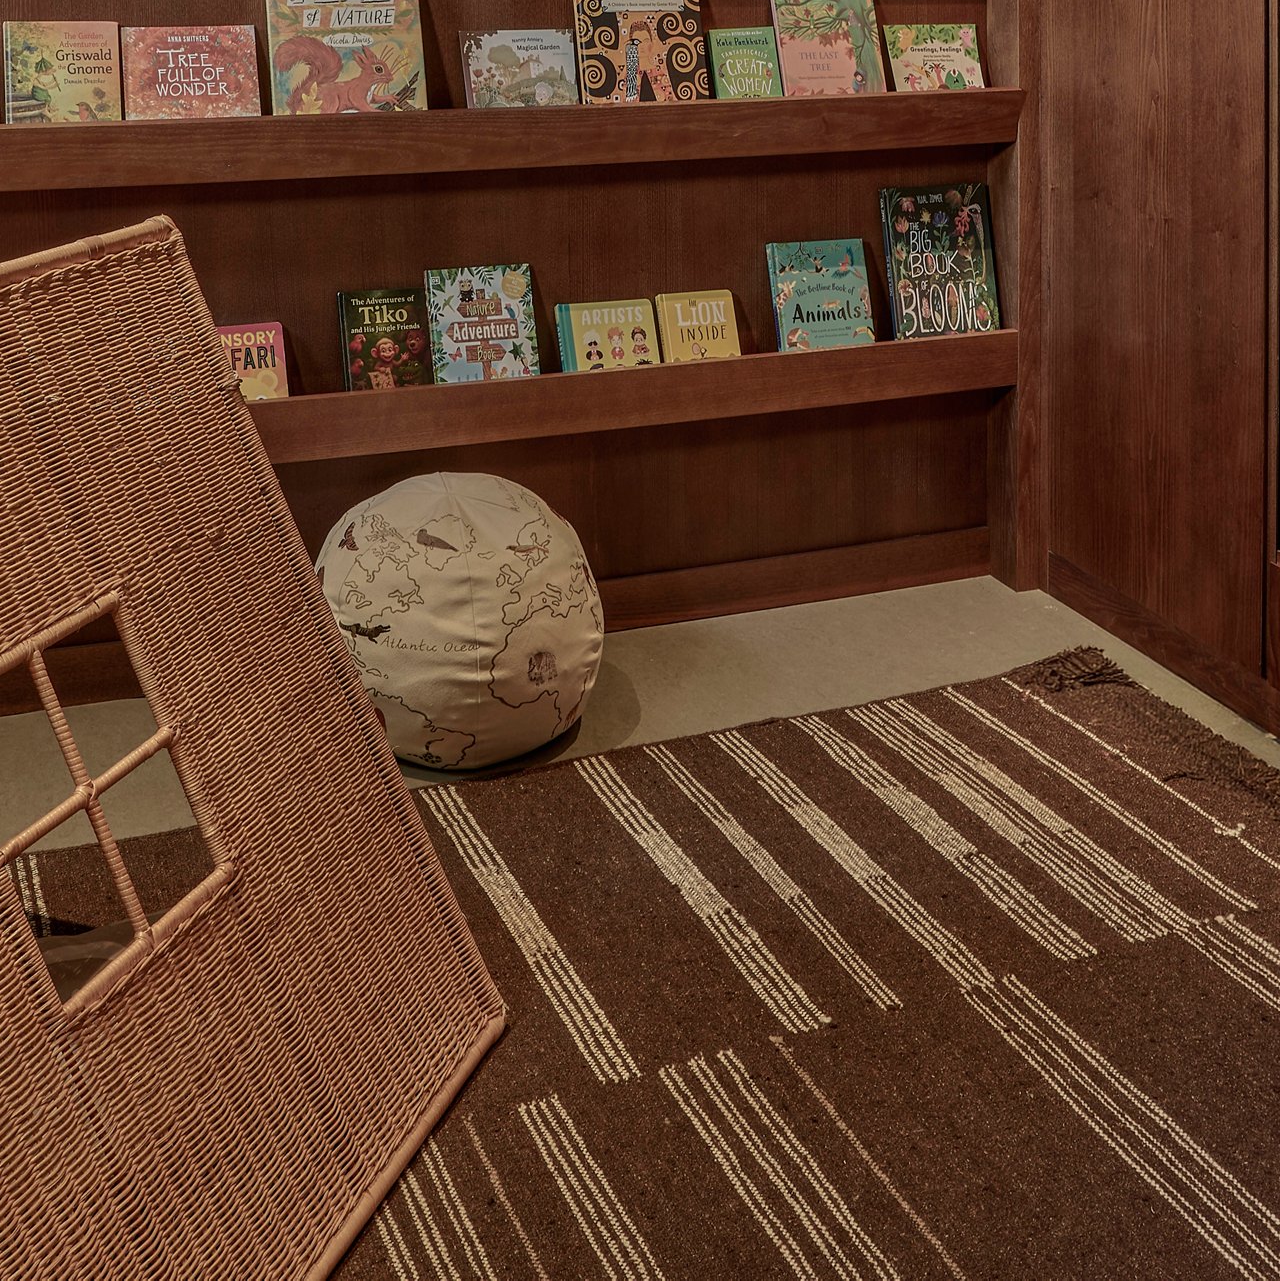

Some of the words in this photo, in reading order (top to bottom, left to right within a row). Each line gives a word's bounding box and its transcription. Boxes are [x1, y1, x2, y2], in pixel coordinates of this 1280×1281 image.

[306, 9, 320, 26] of
[332, 8, 394, 27] NATURE
[59, 40, 99, 48] Adventures
[326, 36, 350, 45] Nicola
[352, 36, 371, 45] Davies
[716, 38, 732, 47] Kate
[734, 37, 768, 46] Pankhurst
[55, 49, 112, 61] Griswald
[156, 47, 212, 68] TREE
[721, 49, 768, 59] FANTASTICALLY
[820, 51, 839, 59] LAST
[67, 63, 113, 74] Gnome
[158, 68, 200, 82] FULL
[202, 67, 225, 81] OF
[726, 59, 766, 76] GREAT
[809, 63, 833, 71] TREE
[156, 82, 229, 97] WONDER
[722, 77, 772, 96] WOMEN
[916, 194, 928, 204] YUVAL
[929, 194, 943, 203] ZOMMER
[909, 222, 920, 230] THE
[910, 230, 932, 254] BIG
[909, 250, 961, 278] BOOK
[796, 289, 807, 297] The
[808, 284, 831, 293] Bedtime
[832, 283, 846, 292] Book
[848, 287, 855, 295] of
[921, 281, 928, 290] OF
[366, 297, 405, 305] Adventures
[466, 301, 496, 317] Nature
[359, 304, 408, 325] Tiko
[581, 306, 644, 326] ARTISTS
[675, 301, 727, 327] LION
[793, 300, 861, 323] Animals
[900, 282, 991, 337] BLOOMS
[376, 325, 396, 333] Jungle
[397, 322, 420, 330] Friends
[453, 323, 517, 341] Adventure
[681, 325, 727, 343] INSIDE
[220, 330, 276, 347] NSORY
[231, 345, 276, 370] FARI
[477, 345, 496, 361] Book
[380, 636, 437, 652] Atlantic
